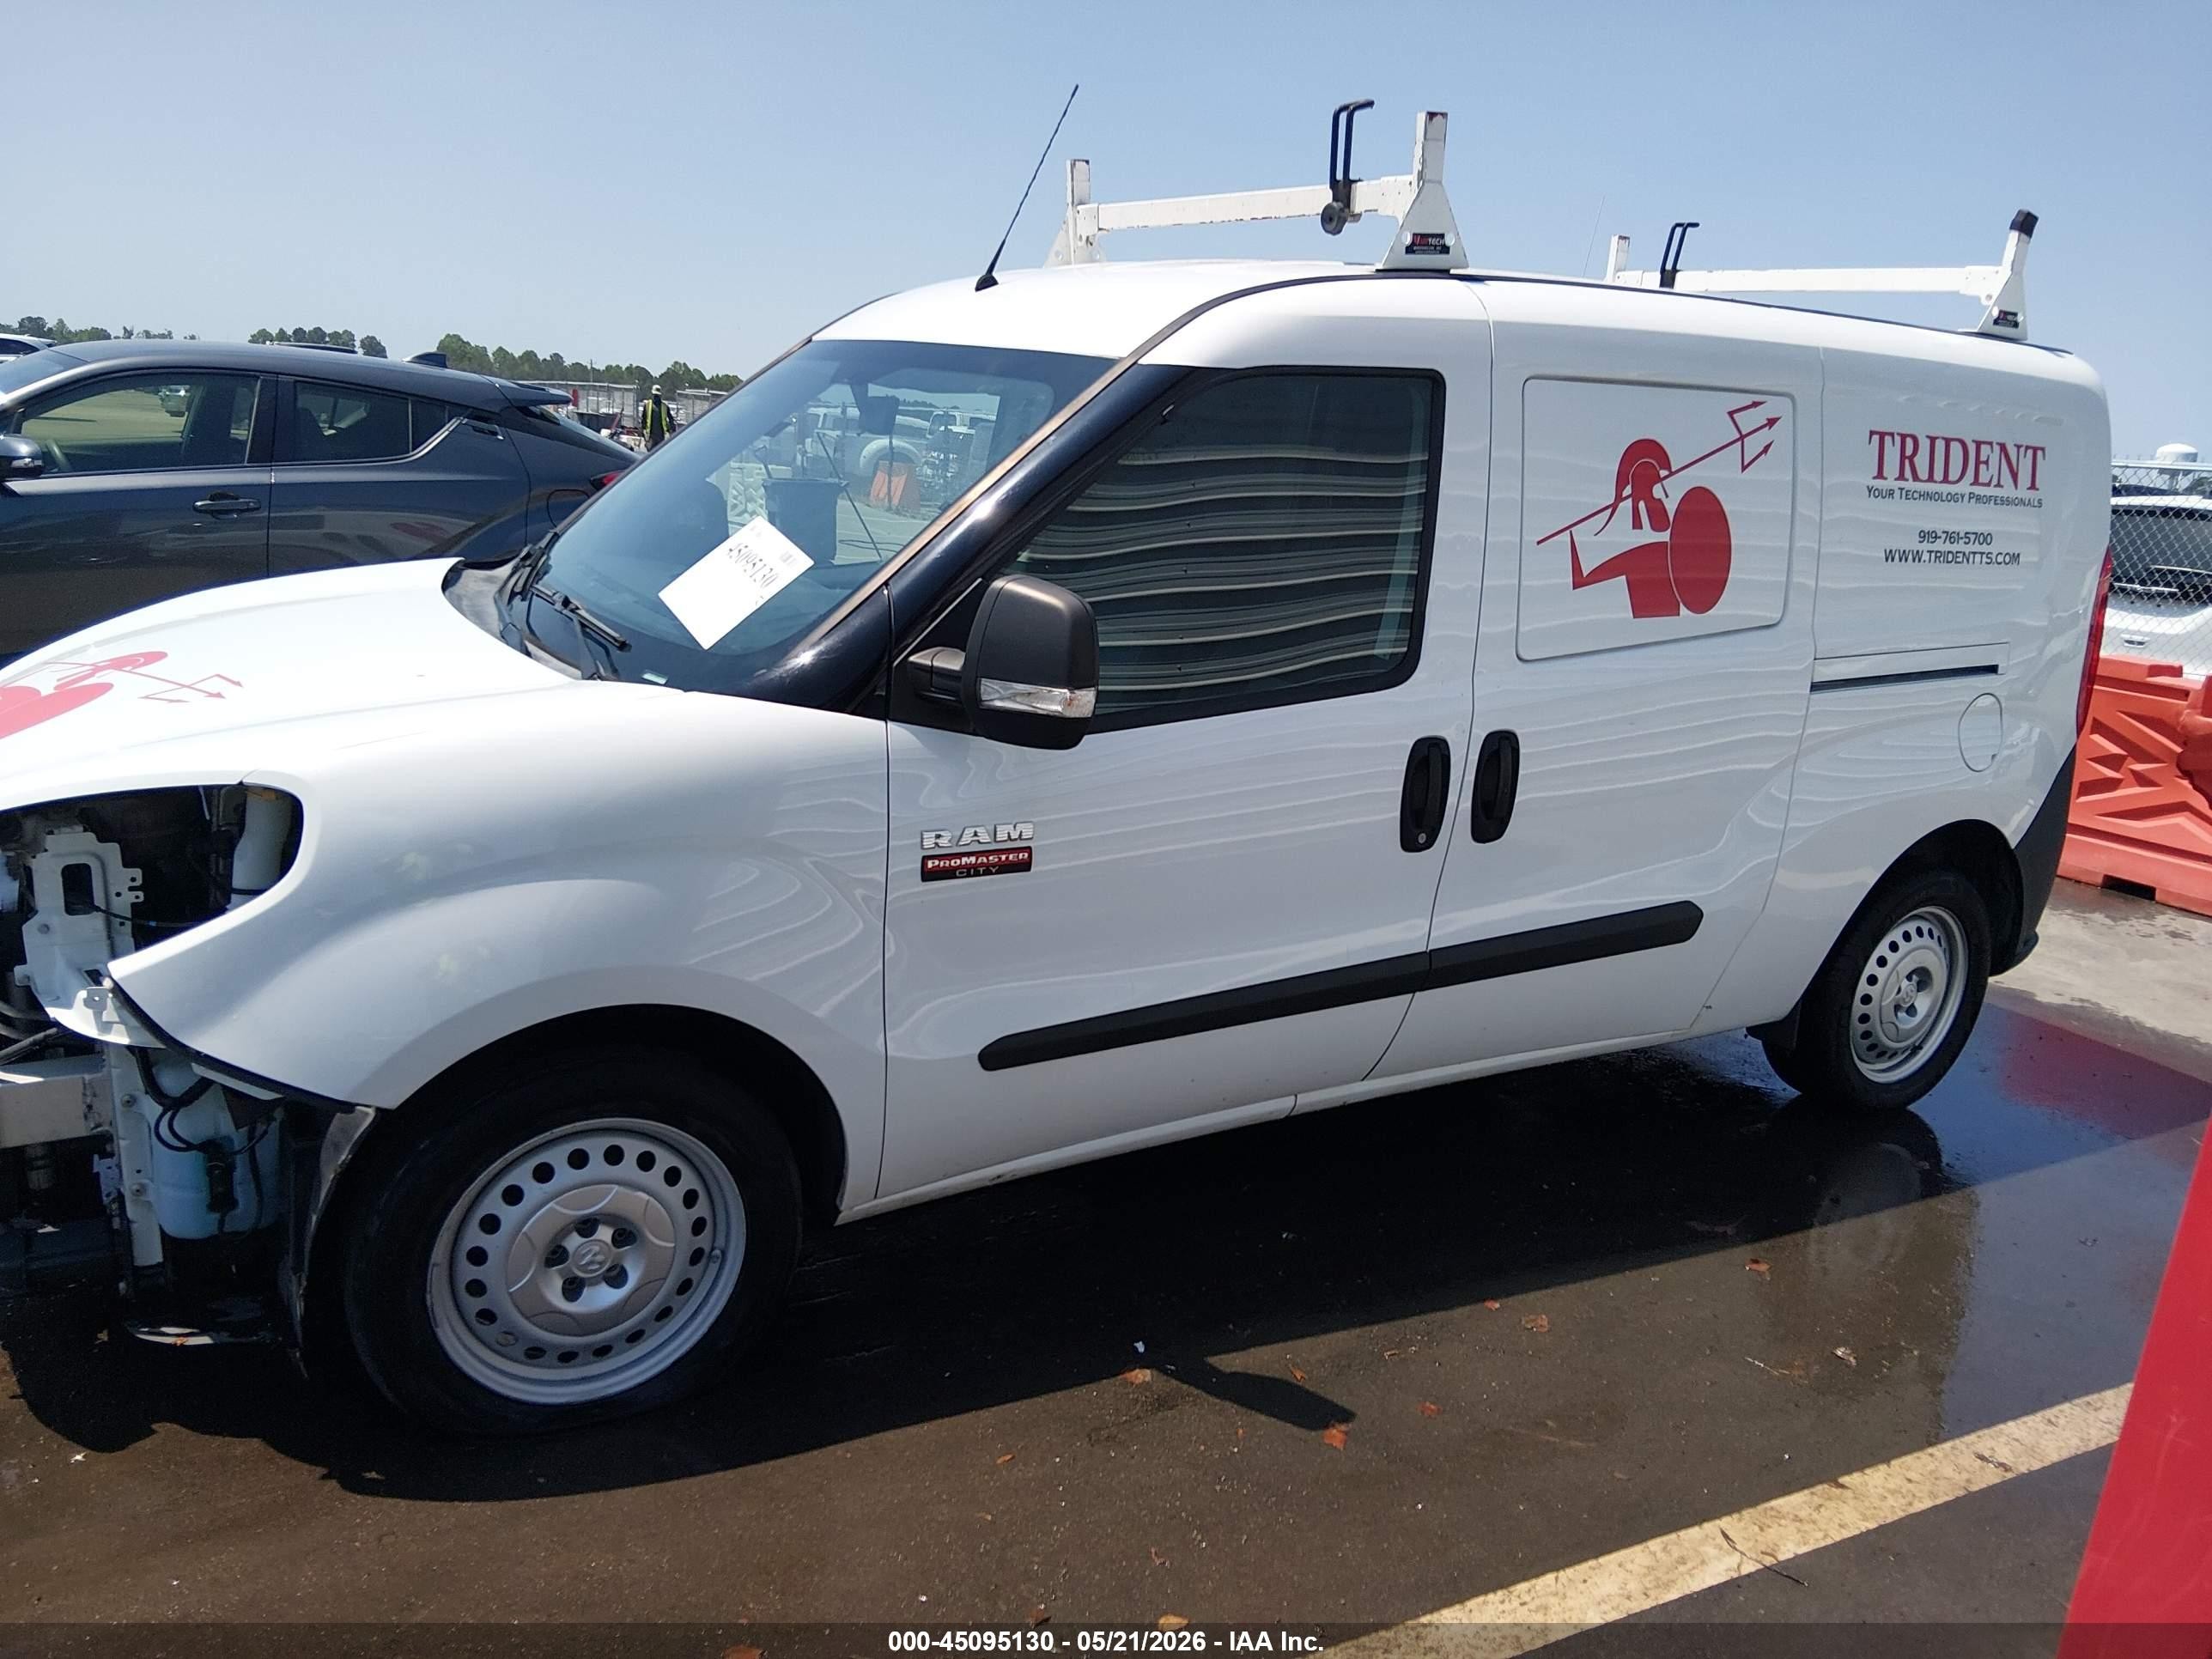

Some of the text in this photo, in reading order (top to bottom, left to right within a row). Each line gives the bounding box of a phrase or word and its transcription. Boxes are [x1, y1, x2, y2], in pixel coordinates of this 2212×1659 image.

[1869, 429, 2046, 491] TRIDENT
[1867, 485, 2043, 508] YOUR TECHNOLOGY PROFESSIONALS
[1917, 530, 1993, 546] 919-761-5700
[1884, 549, 2021, 566] WWW.TRIDENTTS.COM
[921, 822, 1034, 849] RAM
[956, 866, 1000, 877] CITY
